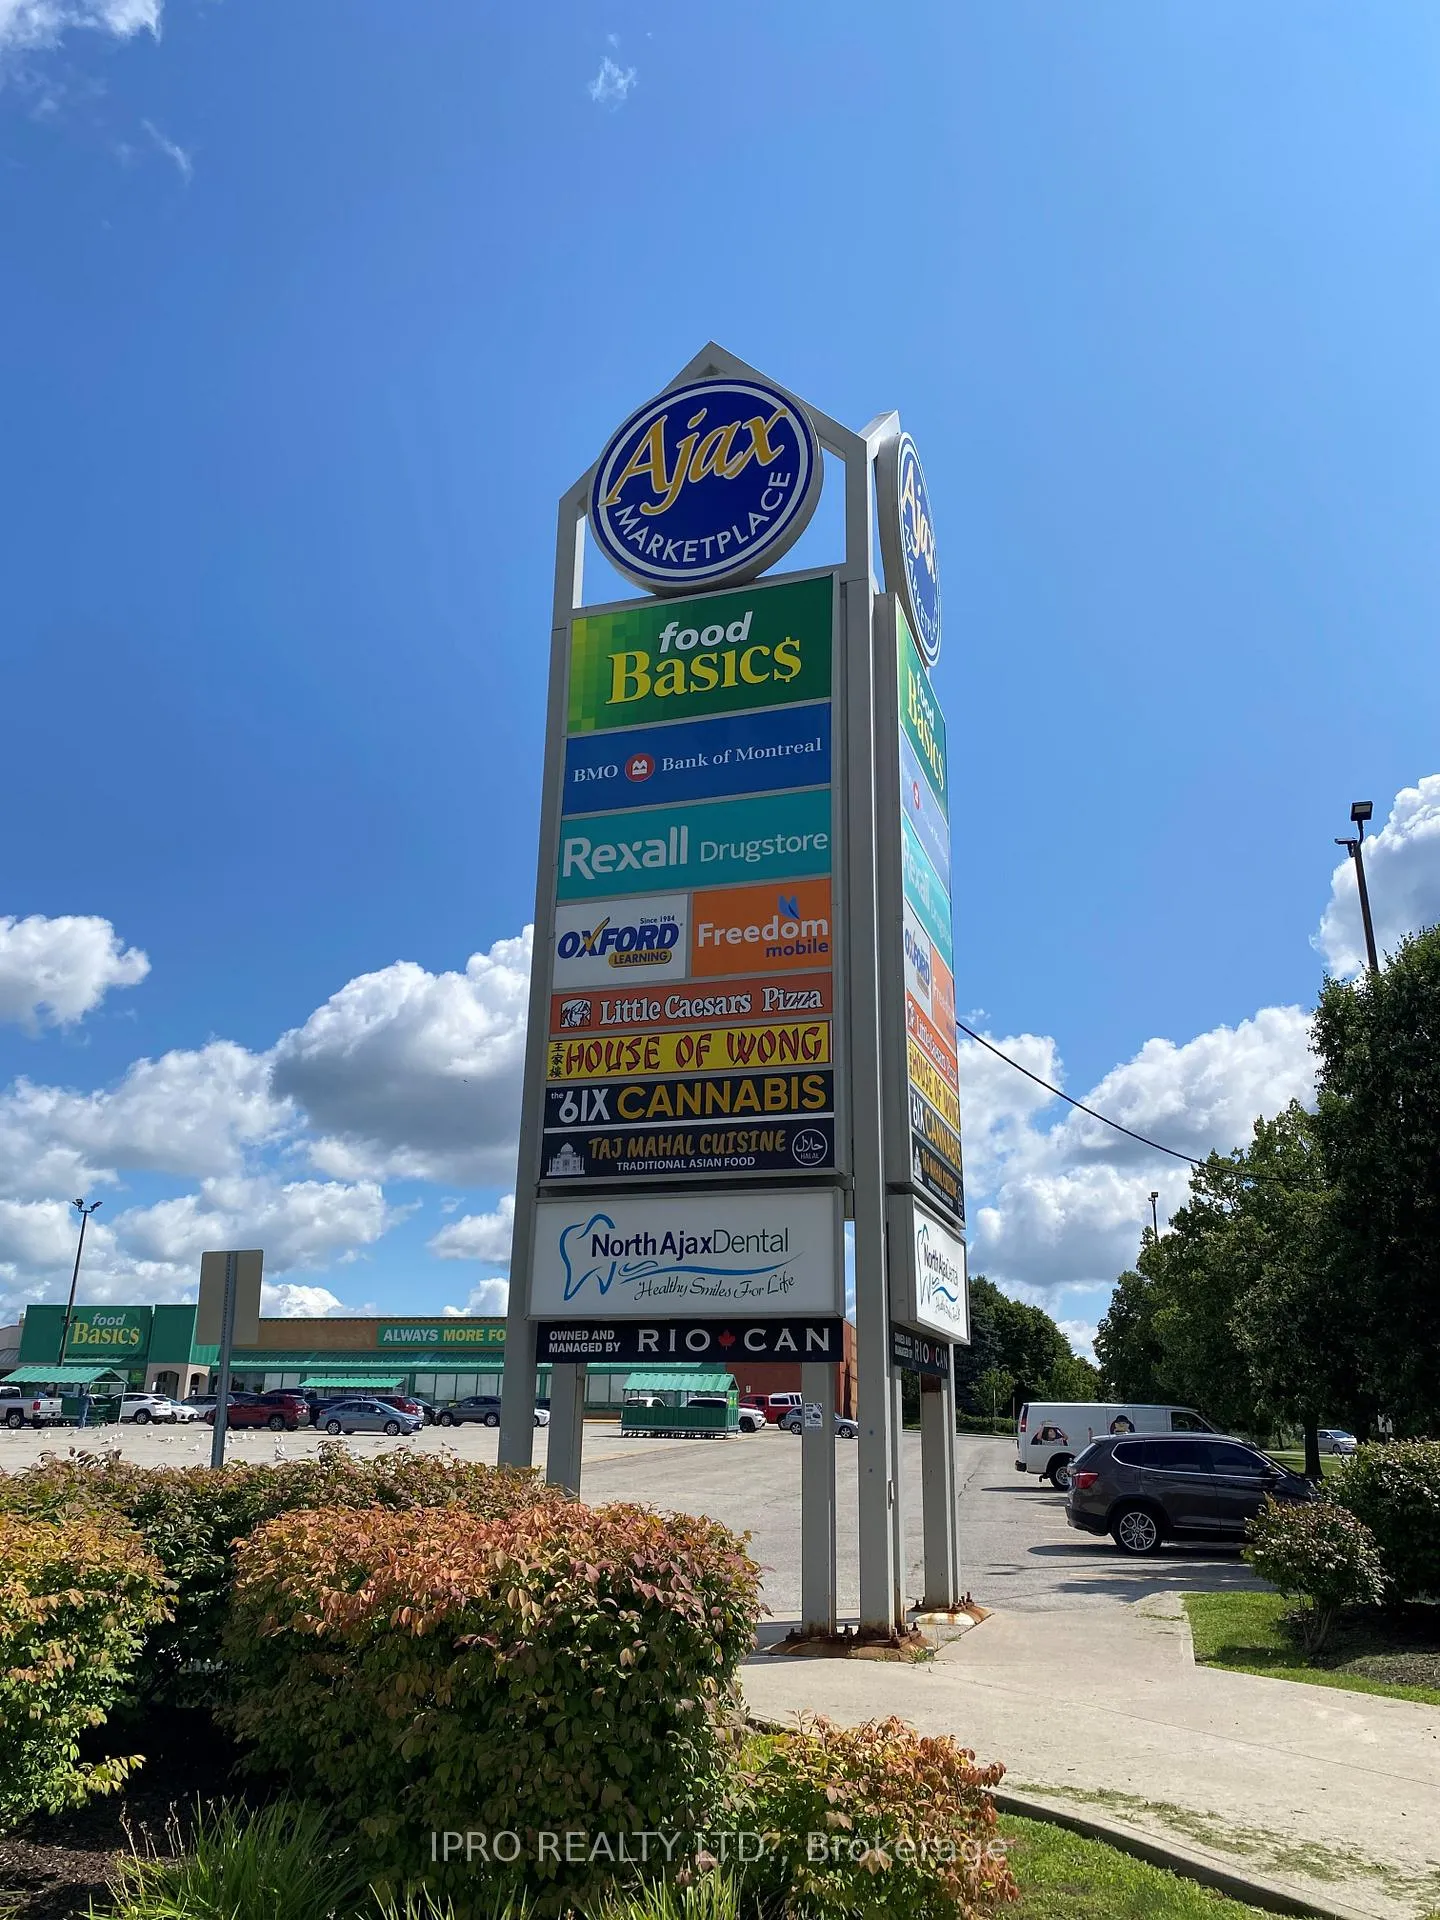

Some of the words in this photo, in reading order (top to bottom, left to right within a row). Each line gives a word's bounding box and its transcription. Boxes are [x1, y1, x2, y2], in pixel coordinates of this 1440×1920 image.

[598, 407, 788, 516] Ajax
[614, 471, 791, 563] MARKETPLACE
[658, 611, 753, 654] food
[573, 764, 618, 783] BMO
[662, 753, 707, 772] Bank
[713, 749, 733, 765] of
[735, 737, 823, 762] Montreal
[562, 825, 689, 880] Rexall
[700, 831, 829, 863] Drugstore
[639, 917, 658, 925] Since
[697, 915, 829, 947] Freedom
[557, 916, 680, 959] OXFORD
[765, 938, 829, 958] mobile
[613, 951, 668, 965] LEARNING
[599, 999, 660, 1025] Little
[664, 990, 753, 1019] Caesars
[763, 986, 823, 1012] Pizza
[566, 1035, 660, 1076] HOUSE
[675, 1033, 712, 1069] OF
[726, 1026, 823, 1066] WONG
[551, 1092, 564, 1100] the
[559, 1088, 611, 1124] 6IX
[617, 1074, 827, 1120] CANNABIS
[588, 1136, 622, 1161] TAJ
[627, 1133, 695, 1159] MAHAL
[699, 1129, 786, 1156] CUISINE
[616, 1160, 687, 1172] TRADITIONAL
[689, 1158, 722, 1169] ASIAN
[724, 1156, 756, 1167] FOOD
[634, 1276, 688, 1300] Healthy
[689, 1277, 732, 1298] Smiles
[733, 1280, 764, 1299] For
[767, 1270, 794, 1295] Life
[92, 1313, 126, 1326] food
[383, 1329, 438, 1342] ALWAYS
[443, 1329, 485, 1342] MORE
[488, 1329, 506, 1342] FO
[549, 1331, 589, 1342] OWNED
[591, 1330, 615, 1341] AND
[549, 1343, 603, 1354] MANAGED
[605, 1342, 621, 1353] BY
[637, 1328, 711, 1352] RIO
[743, 1327, 830, 1352] CAN
[914, 1339, 929, 1364] RIO
[935, 1346, 948, 1370] CAN
